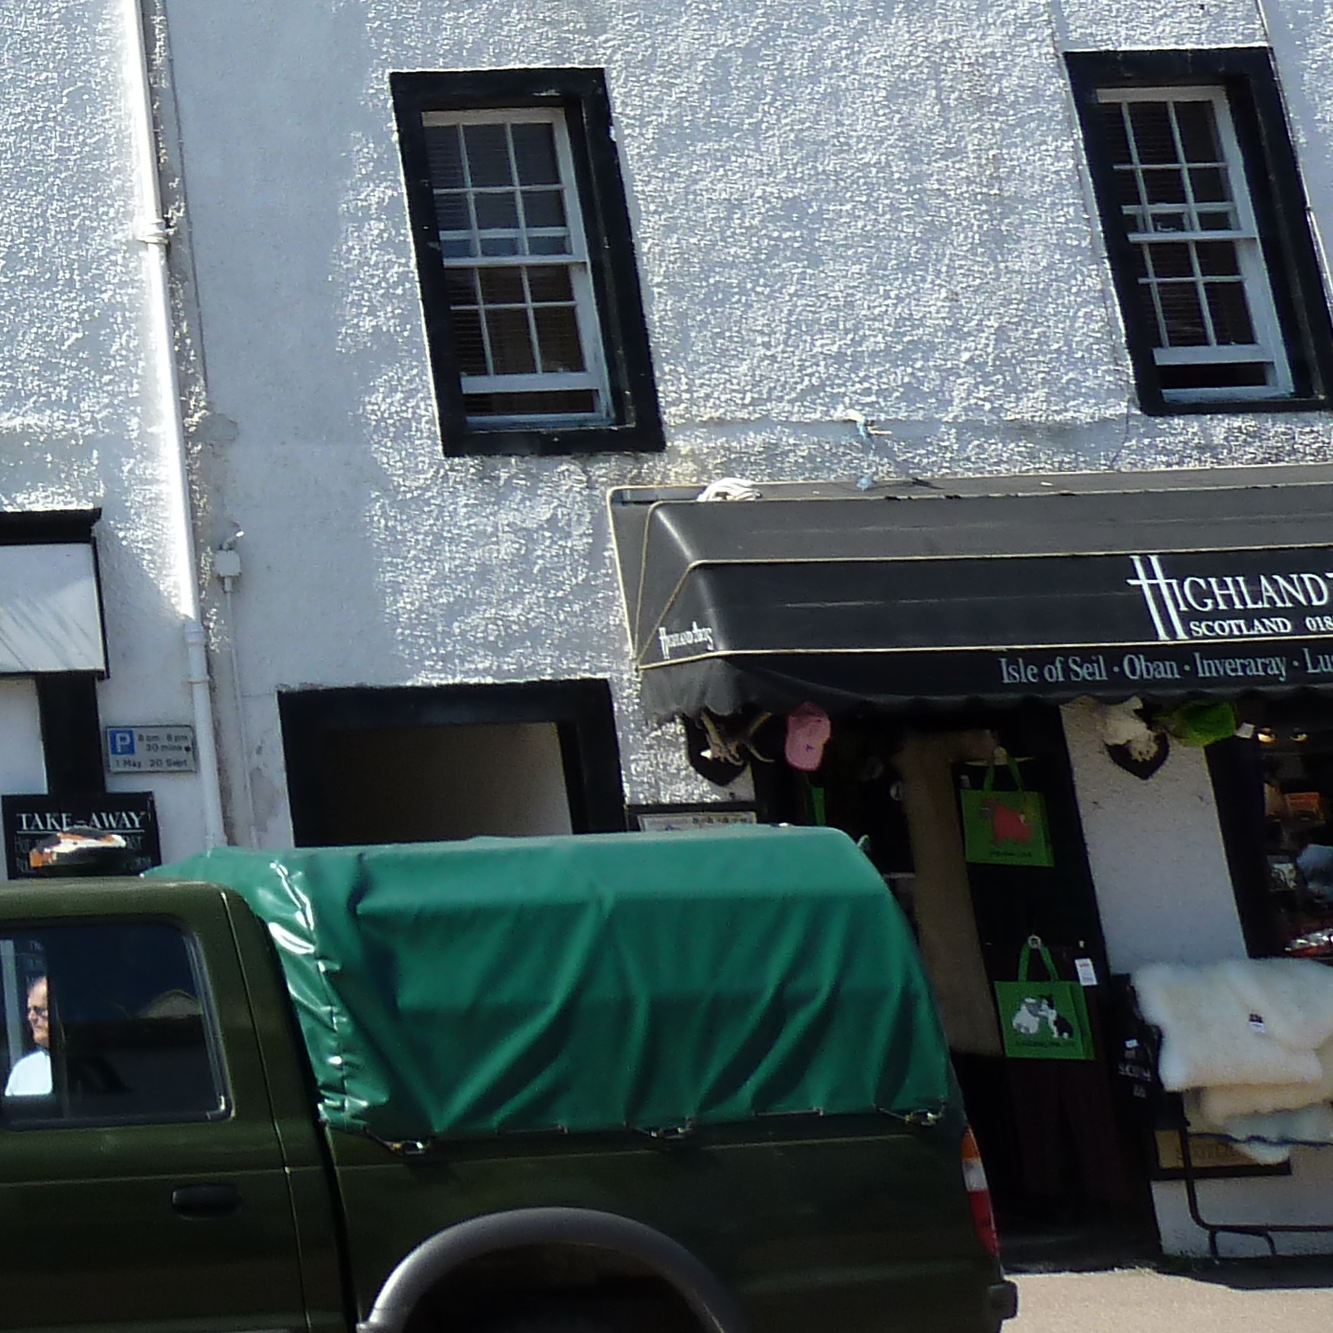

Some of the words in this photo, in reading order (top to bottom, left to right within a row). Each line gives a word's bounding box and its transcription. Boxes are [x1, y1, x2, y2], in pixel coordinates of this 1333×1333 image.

[1126, 555, 1329, 640] HIGHLAND
[1189, 618, 1292, 637] SCOTLAND
[1000, 656, 1037, 684] Isle
[1043, 657, 1065, 682] of
[1068, 655, 1108, 682] Seil
[1122, 653, 1180, 680] Oban
[1193, 651, 1287, 681] Inveraray
